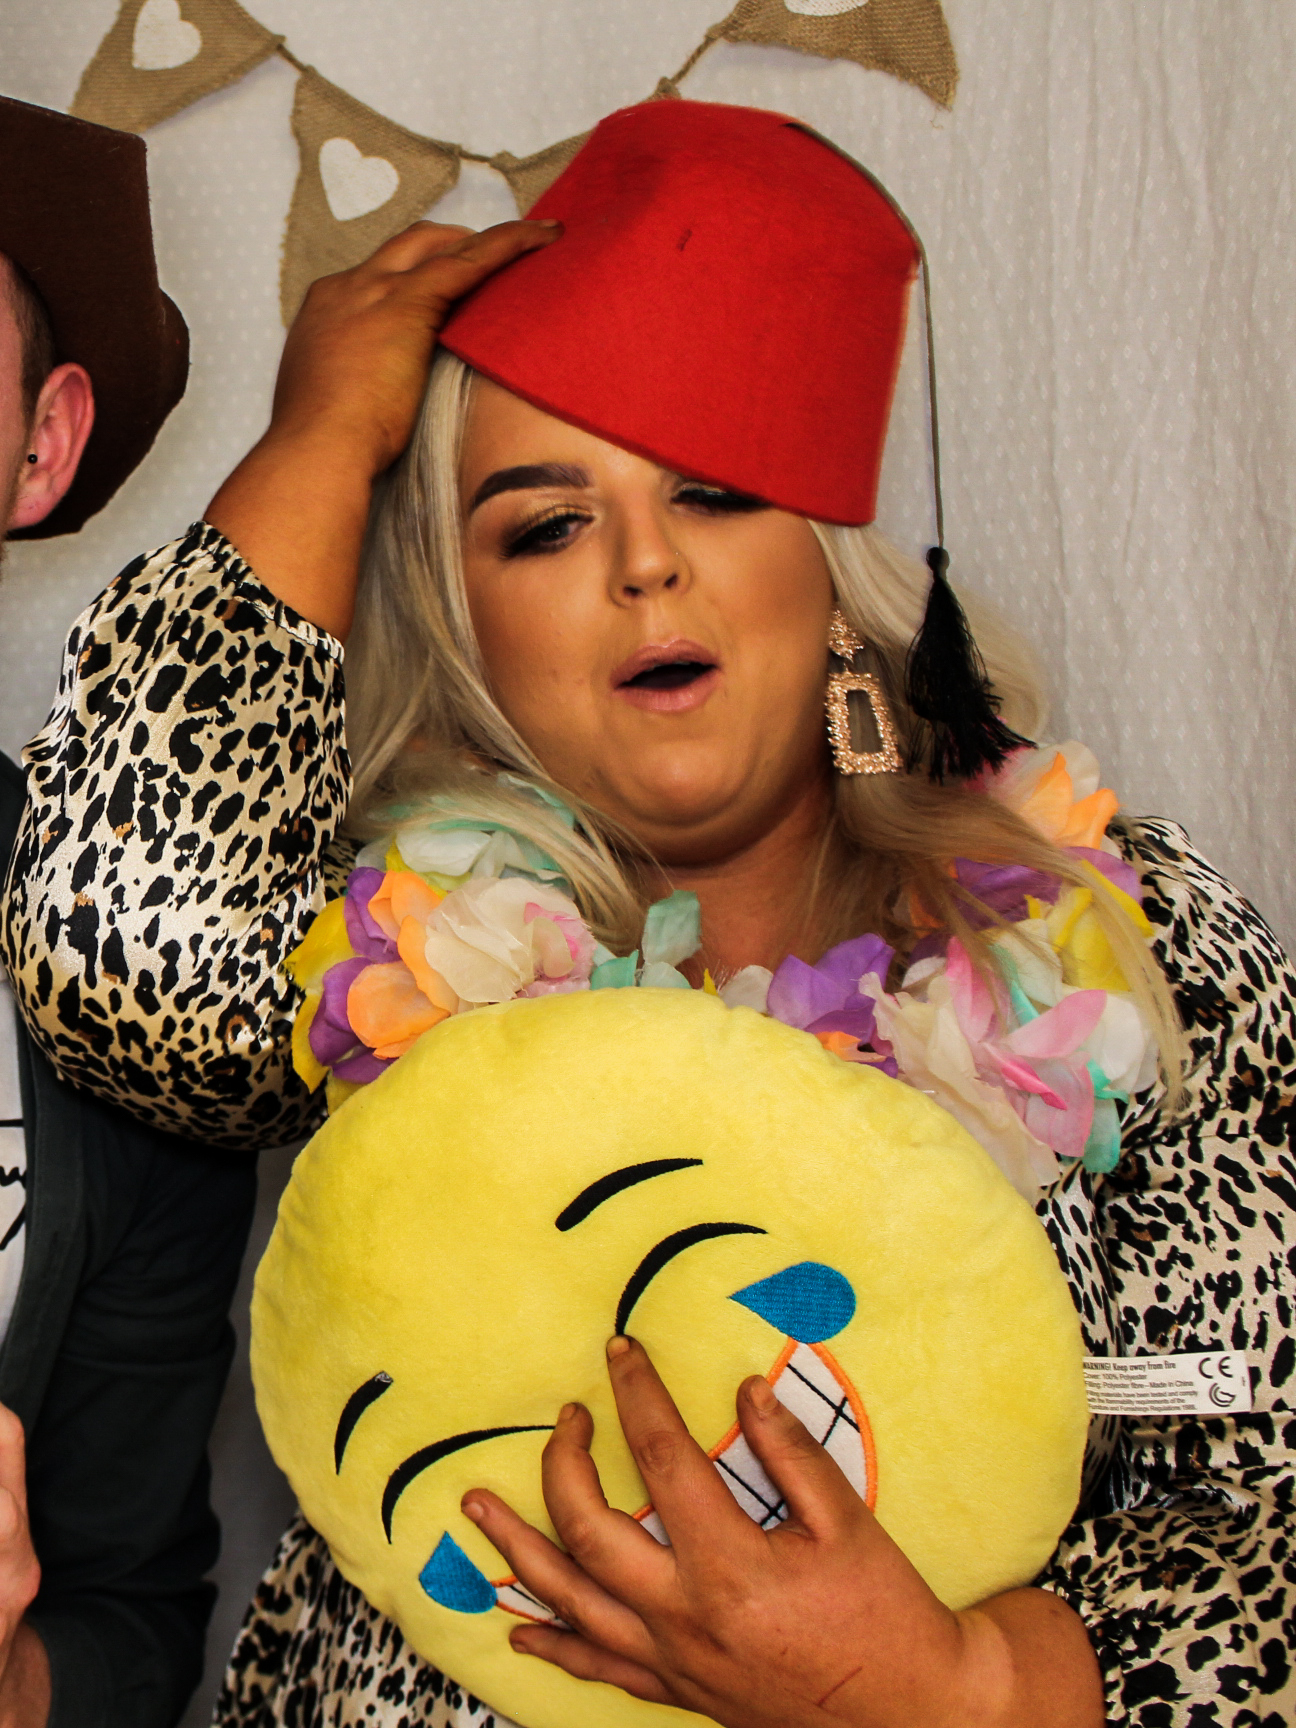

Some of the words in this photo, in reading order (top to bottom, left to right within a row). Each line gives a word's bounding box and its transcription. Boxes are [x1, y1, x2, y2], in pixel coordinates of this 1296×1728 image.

[1112, 1362, 1128, 1373] Keep
[1129, 1364, 1146, 1373] away
[1147, 1360, 1164, 1370] from
